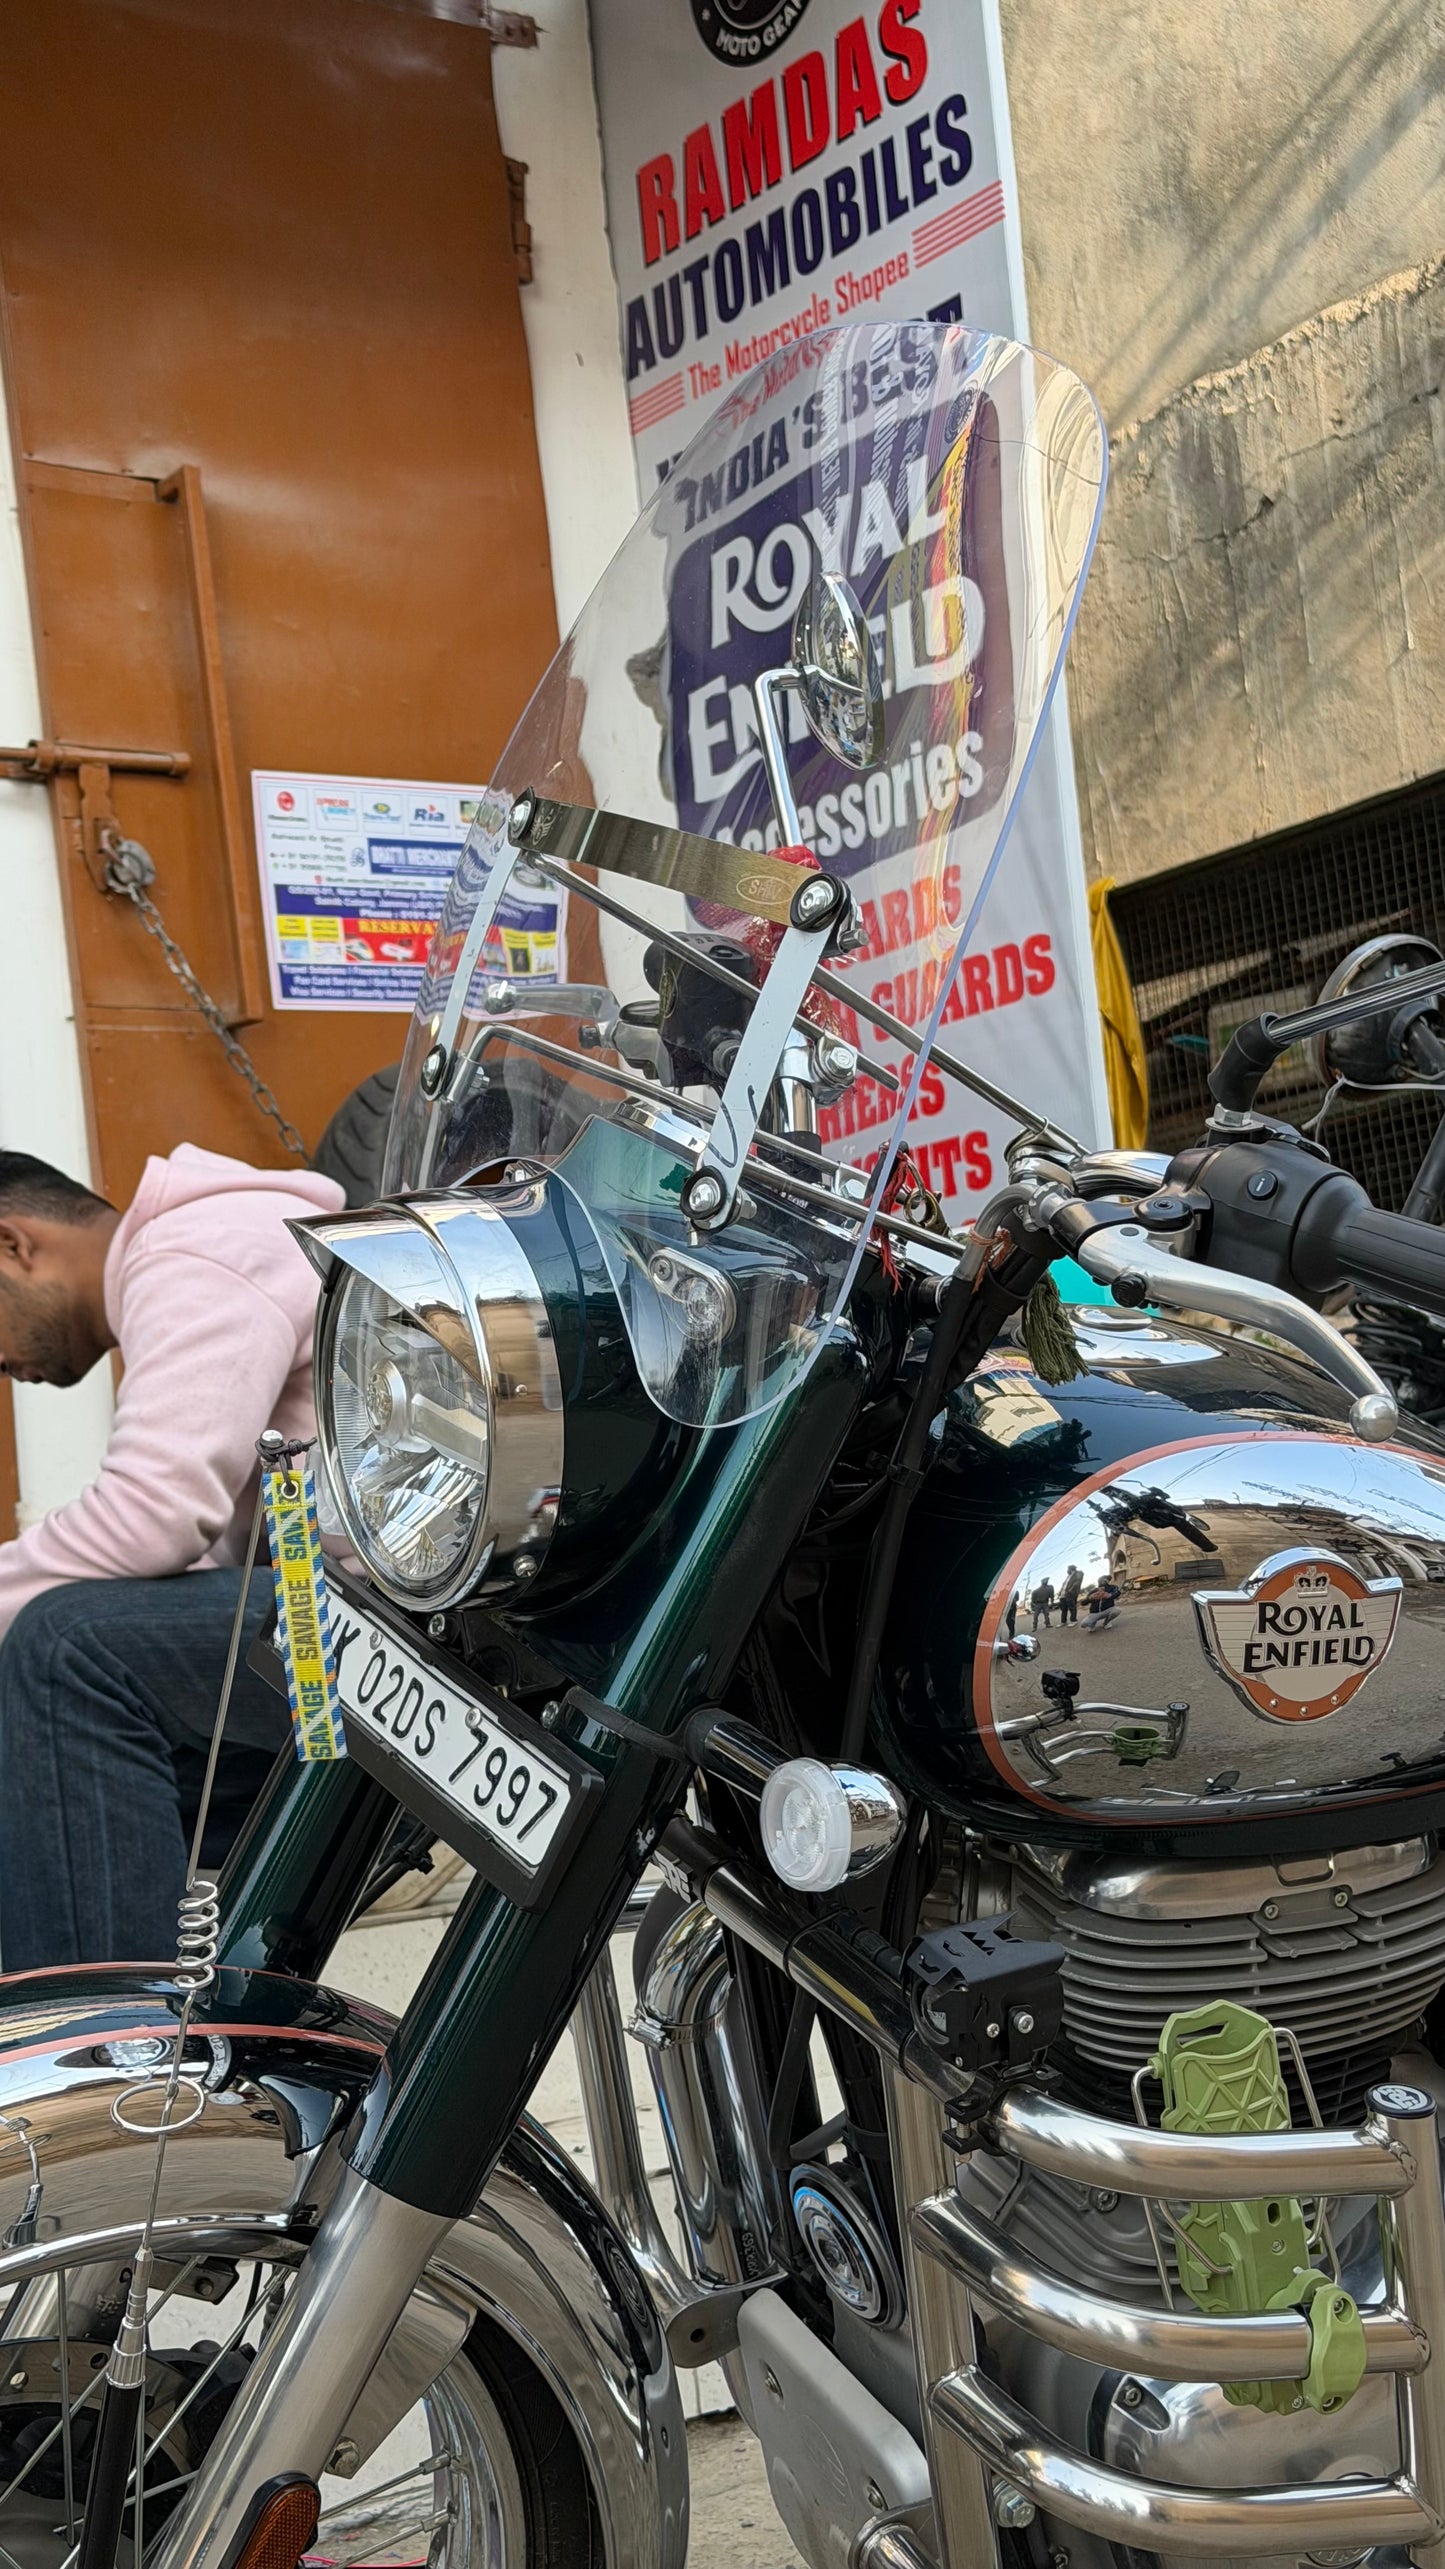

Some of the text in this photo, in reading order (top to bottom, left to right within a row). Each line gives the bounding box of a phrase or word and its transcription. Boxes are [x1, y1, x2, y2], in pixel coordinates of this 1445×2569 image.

[715, 28, 761, 57] MOTO
[636, 0, 928, 267] RAMDAS
[626, 93, 973, 381] AUTOMOBILES
[687, 359, 722, 400] The
[724, 292, 831, 380] Motorcycle
[834, 251, 909, 315] Shopee
[710, 456, 949, 650] ROYAL
[358, 919, 437, 936] RESERVA
[288, 1577, 321, 1661] SAVAGE
[1242, 1635, 1376, 1673] ENFIELD
[1257, 1601, 1365, 1636] ROYAL
[356, 1649, 446, 1758] 02DS
[449, 1727, 558, 1841] 7997
